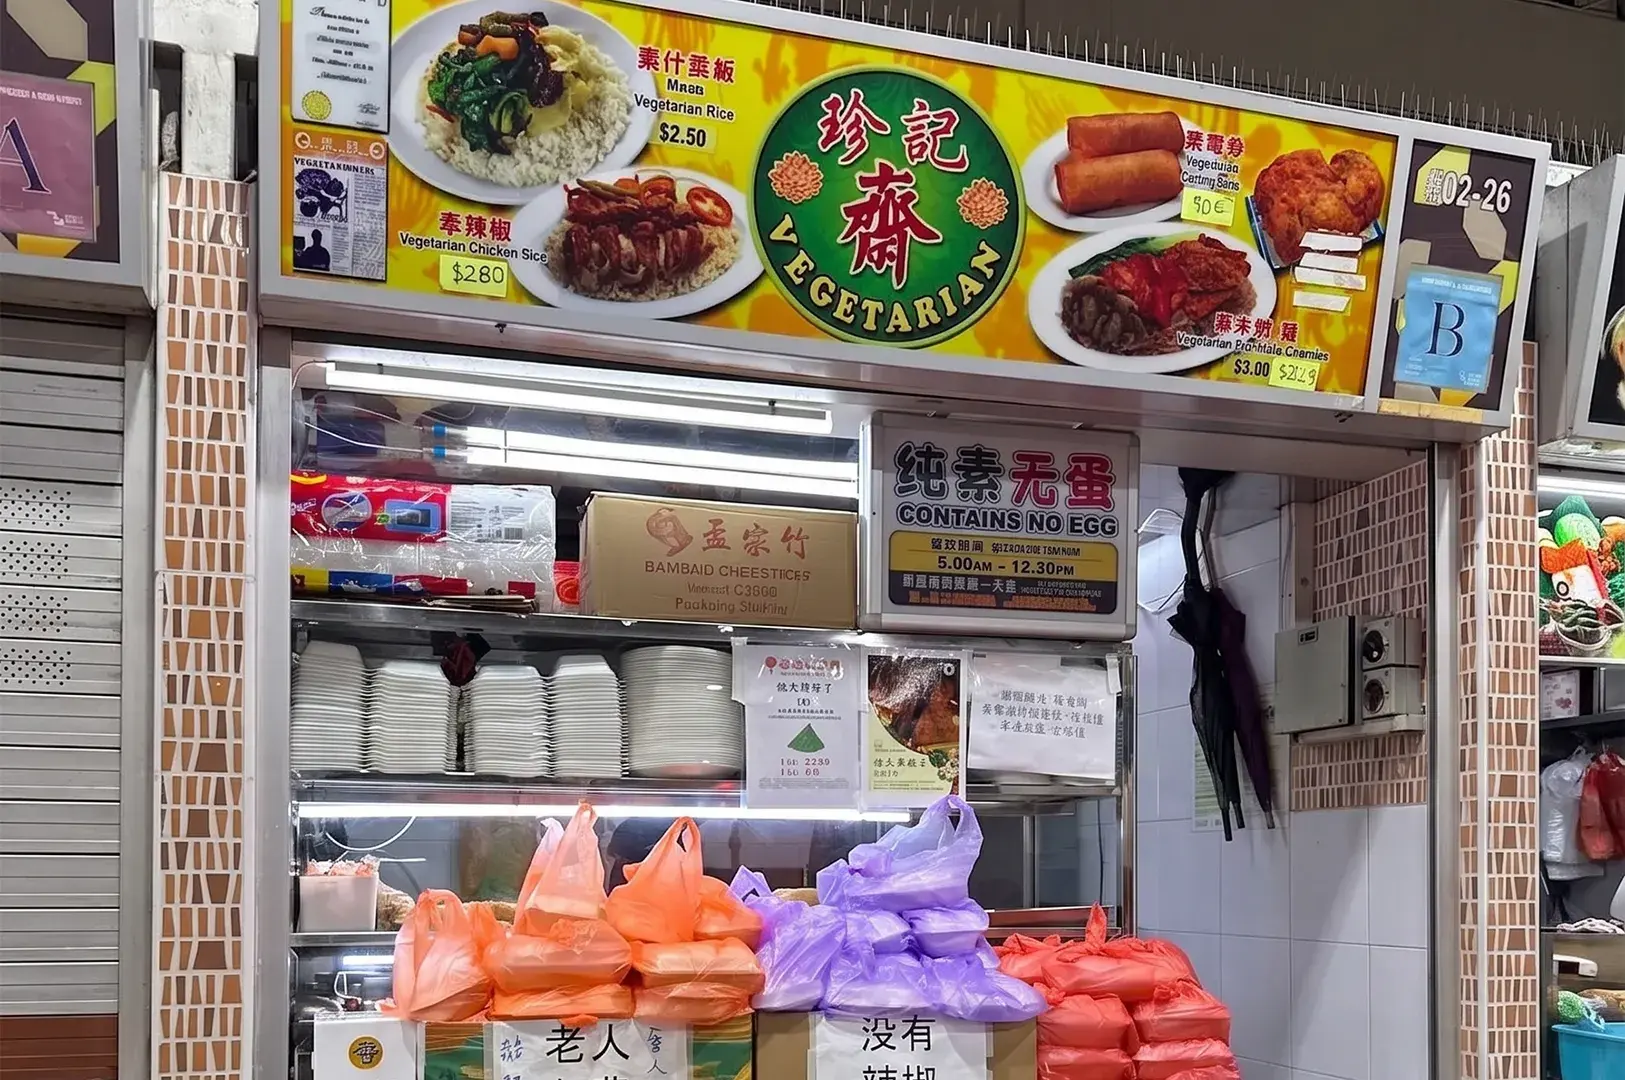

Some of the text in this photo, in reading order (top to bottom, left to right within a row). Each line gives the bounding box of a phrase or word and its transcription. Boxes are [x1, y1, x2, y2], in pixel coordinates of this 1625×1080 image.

[634, 93, 735, 121] Vegetarian Rice
[659, 122, 706, 148] $2.50
[399, 232, 466, 252] Vegetarian
[469, 241, 519, 259] Chicken
[769, 213, 1001, 334] VEGETARIAN
[1425, 299, 1466, 359] B
[1233, 358, 1270, 378] $3.00
[893, 441, 1116, 511] 纯素无蛋
[897, 502, 1119, 538] CONTAINS NO EGG
[937, 556, 992, 572] 5.00AM
[1012, 560, 1074, 576] 12.30PM
[546, 1023, 630, 1064] 老人
[862, 1014, 935, 1052] 没有
